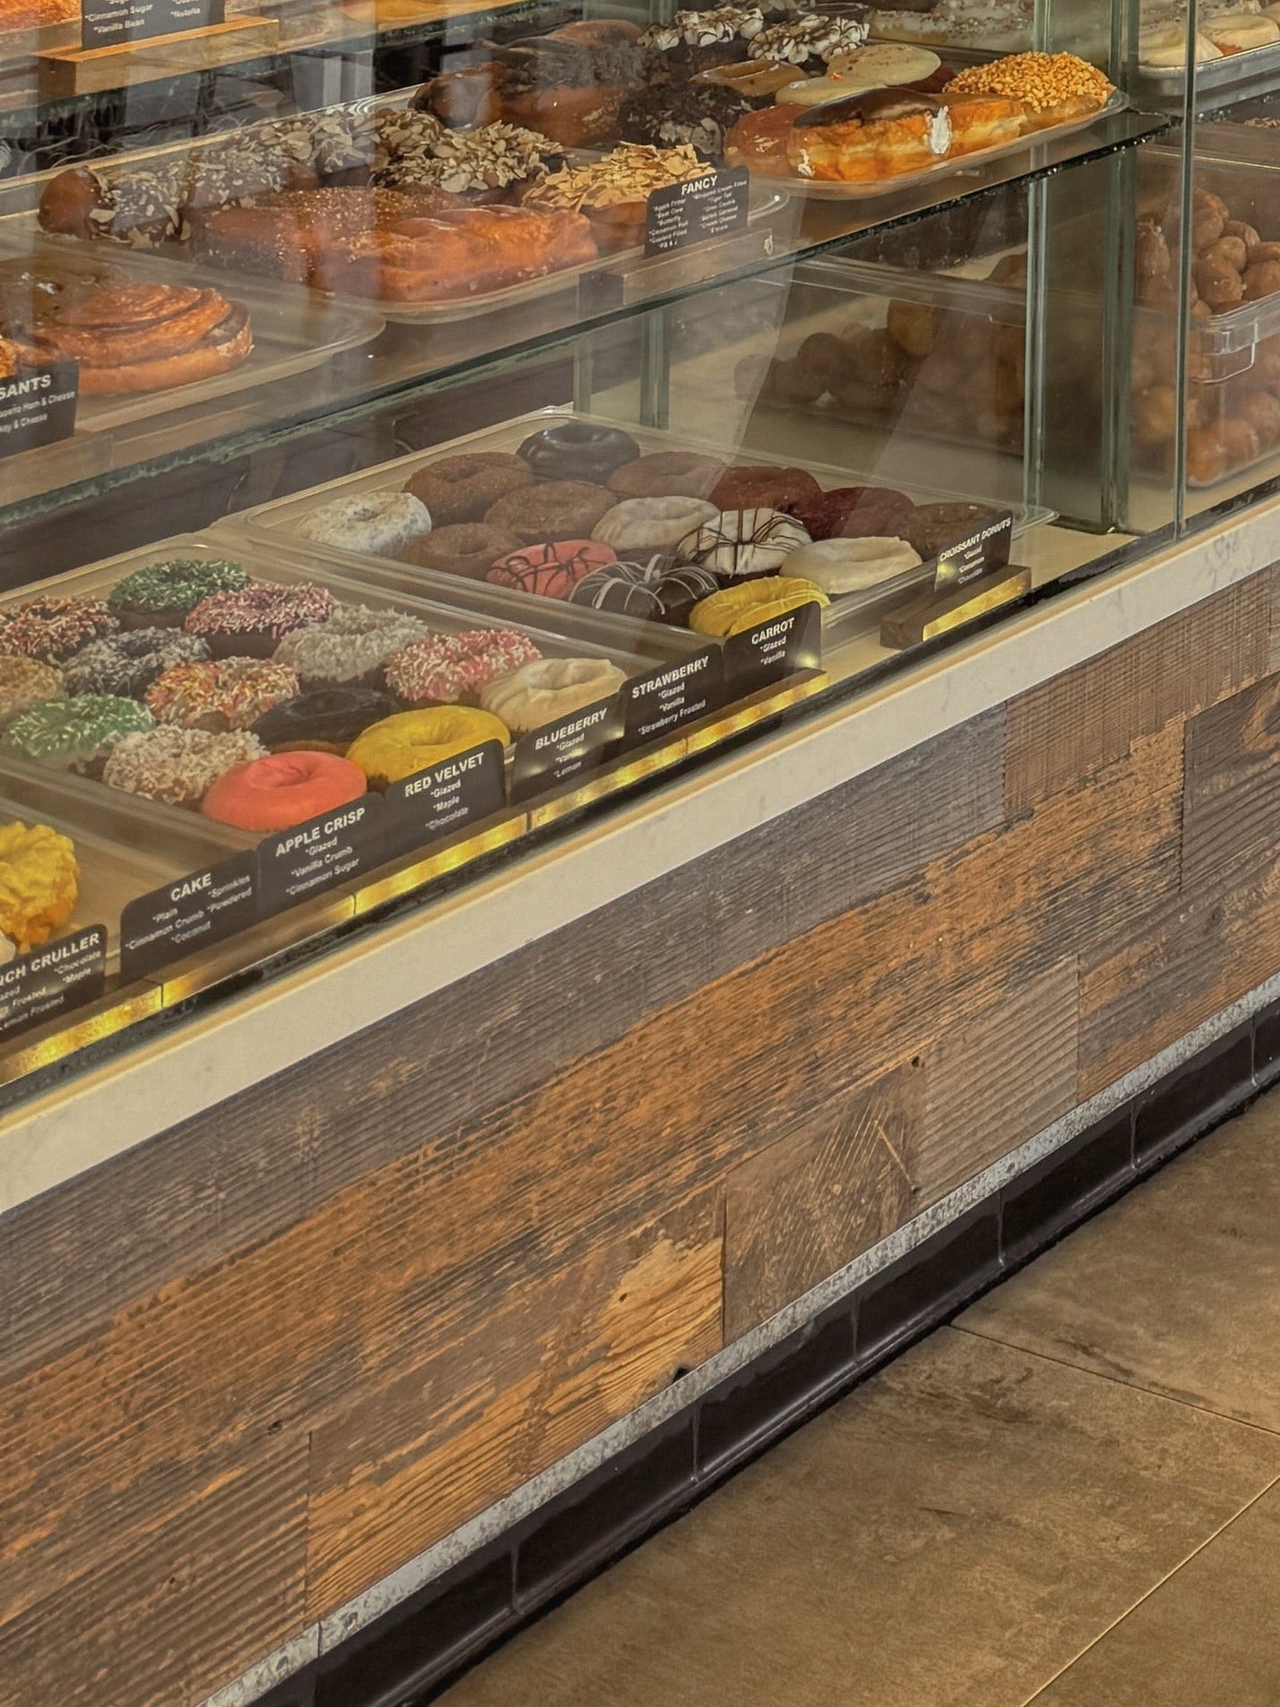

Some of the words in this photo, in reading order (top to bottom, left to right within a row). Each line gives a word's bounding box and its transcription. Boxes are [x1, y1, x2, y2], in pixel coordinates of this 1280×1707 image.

[681, 175, 718, 195] FANCY
[940, 533, 980, 562] CROISSANT
[981, 516, 1011, 540] DONUTS
[751, 617, 795, 645] CARROT
[631, 655, 709, 699] STRAWBERRY
[535, 707, 608, 750] BLUEBERRY
[404, 776, 432, 798] RED
[434, 752, 484, 783] VELVET
[275, 827, 320, 857] APPLE
[324, 807, 365, 834] CRISP
[324, 846, 353, 863] Crumb
[334, 858, 360, 875] Sugar
[170, 873, 212, 902] CAKE
[175, 910, 204, 928] Crumb
[31, 933, 99, 972] CRULLER
